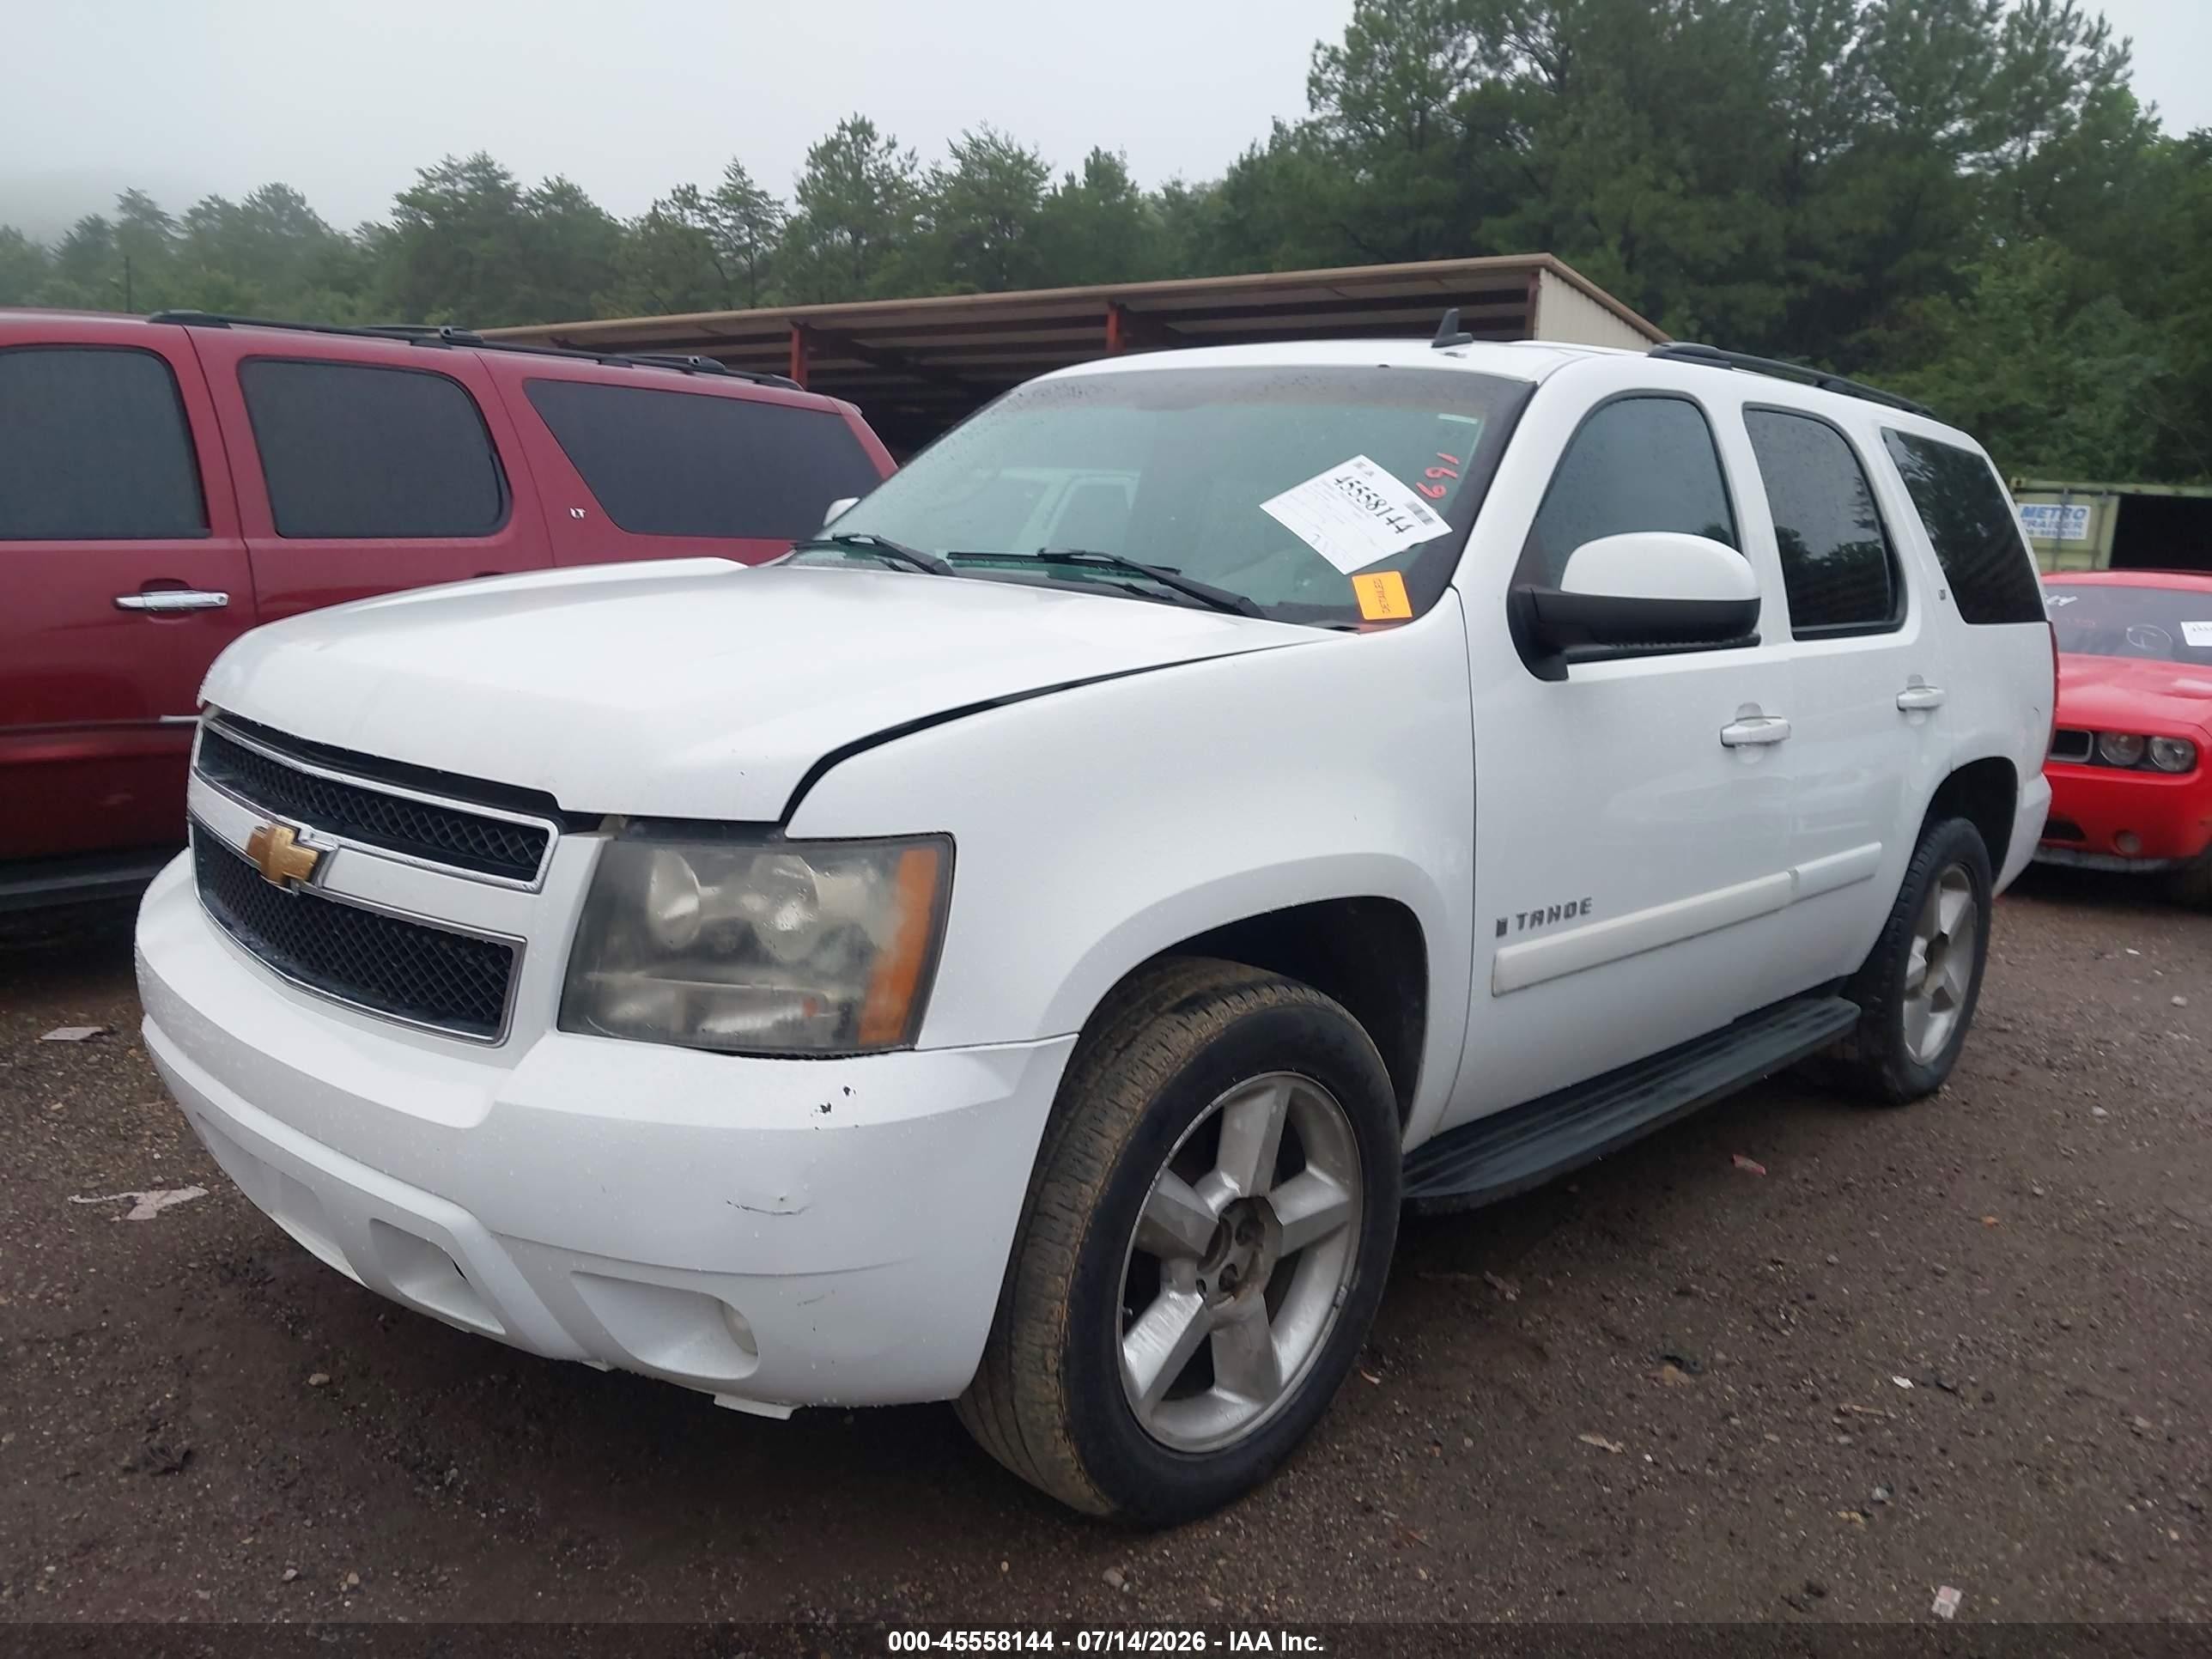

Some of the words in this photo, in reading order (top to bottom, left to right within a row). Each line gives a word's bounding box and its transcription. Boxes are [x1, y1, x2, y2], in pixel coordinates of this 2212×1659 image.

[1334, 475, 1415, 534] 45558144
[2020, 507, 2087, 520] METRO
[1516, 896, 1593, 932] TAHOE
